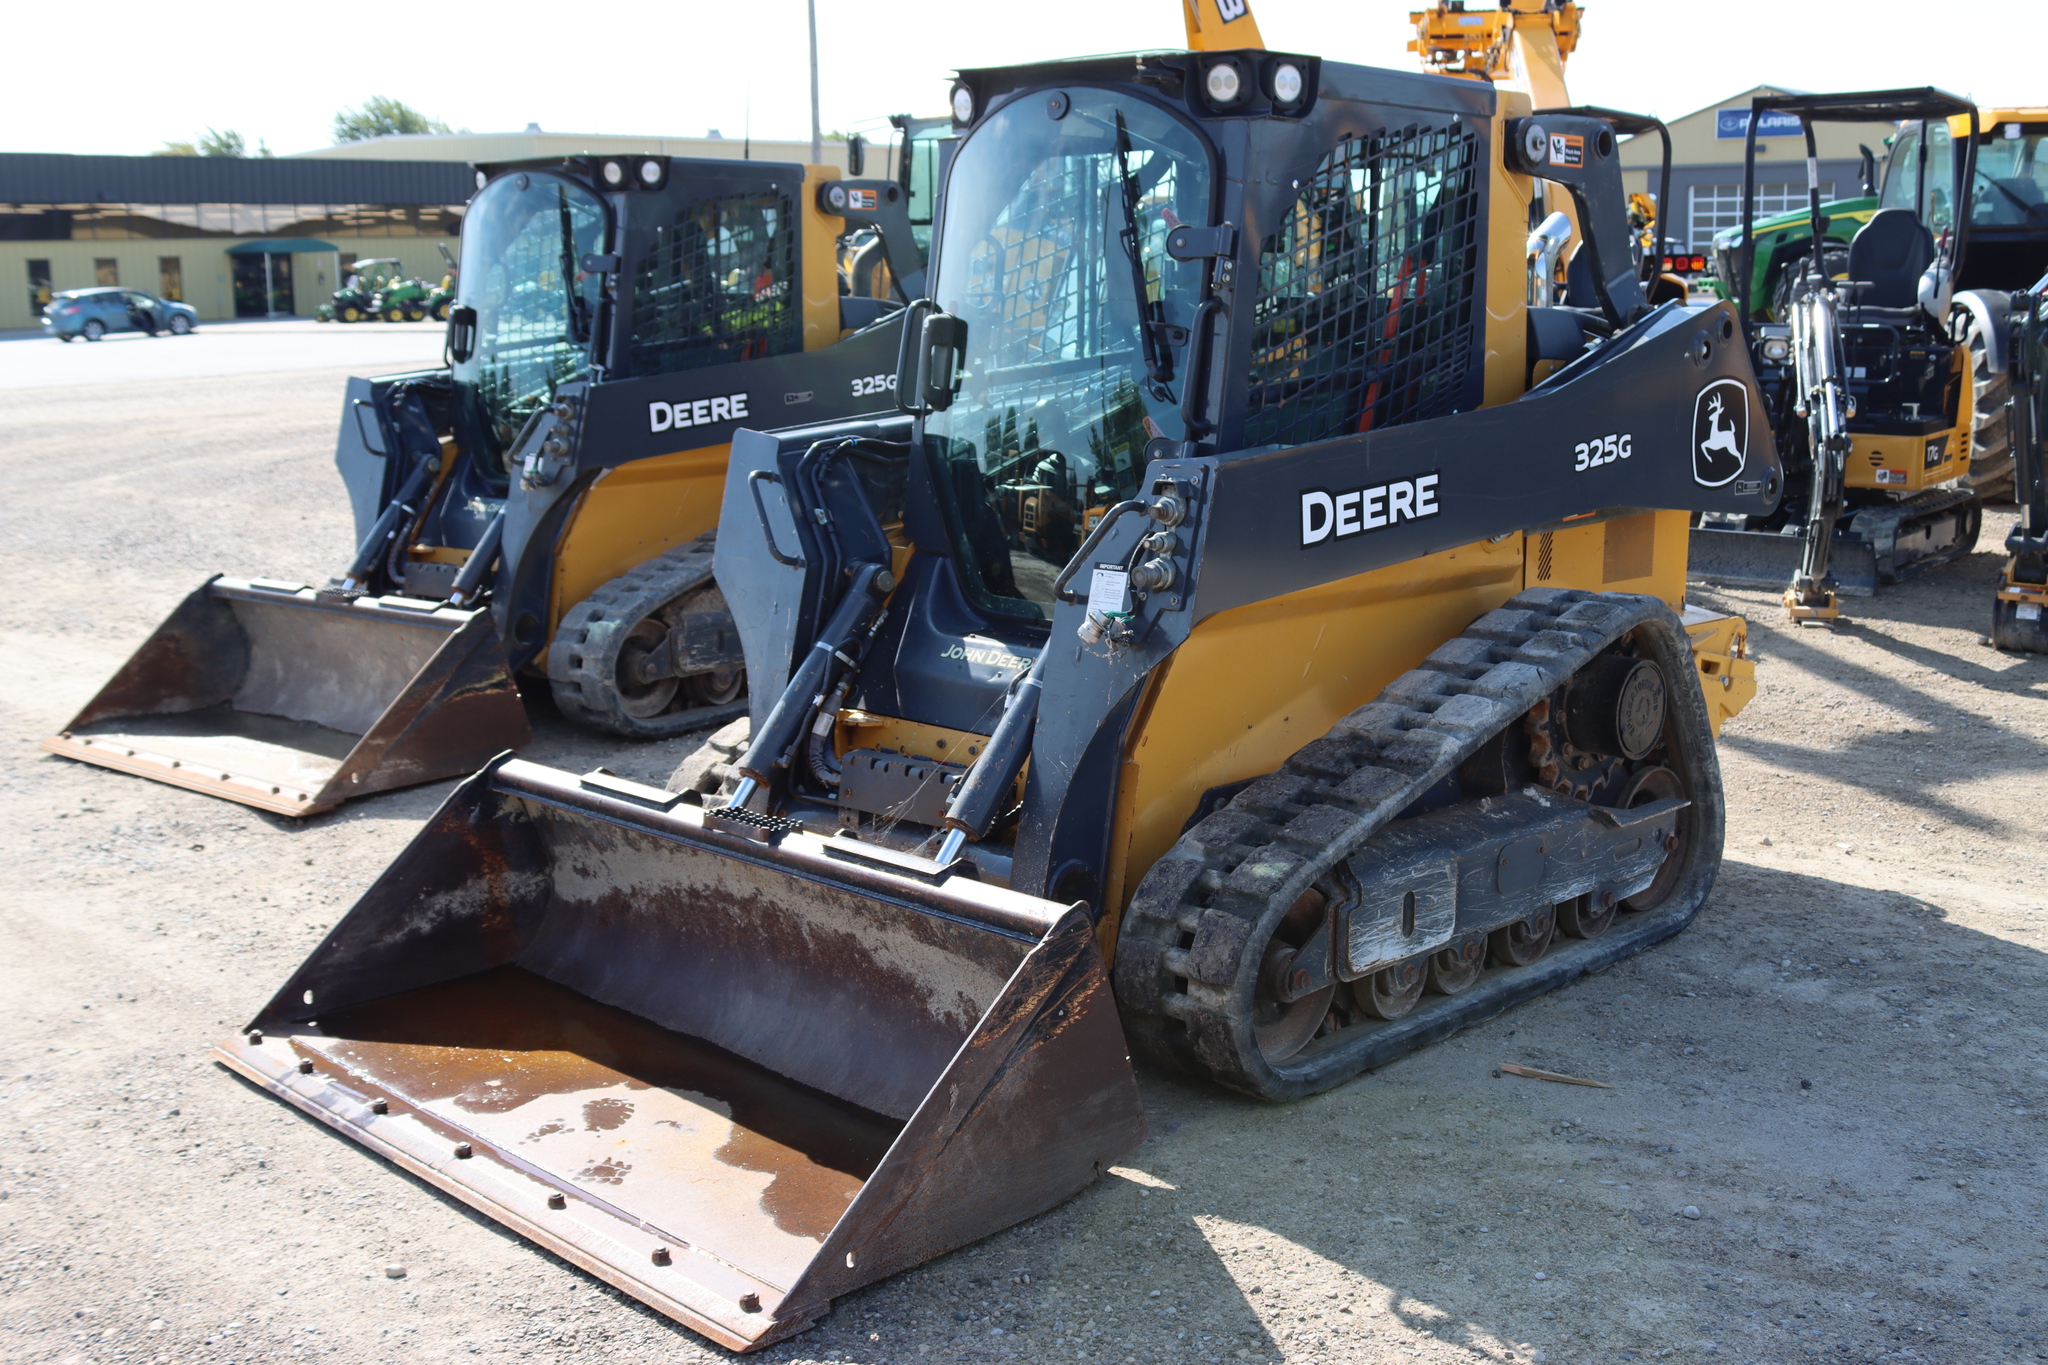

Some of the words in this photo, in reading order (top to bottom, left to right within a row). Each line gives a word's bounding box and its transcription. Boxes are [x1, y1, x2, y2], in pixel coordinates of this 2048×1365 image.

[1739, 116, 1801, 129] PLARIS
[649, 393, 749, 433] DEERE
[1575, 434, 1632, 472] 325G
[1927, 445, 1939, 462] 17G
[1302, 474, 1439, 545] DEERE
[1099, 563, 1124, 571] IMPORTANT
[941, 644, 986, 664] JOHN
[985, 648, 1034, 670] DEER
